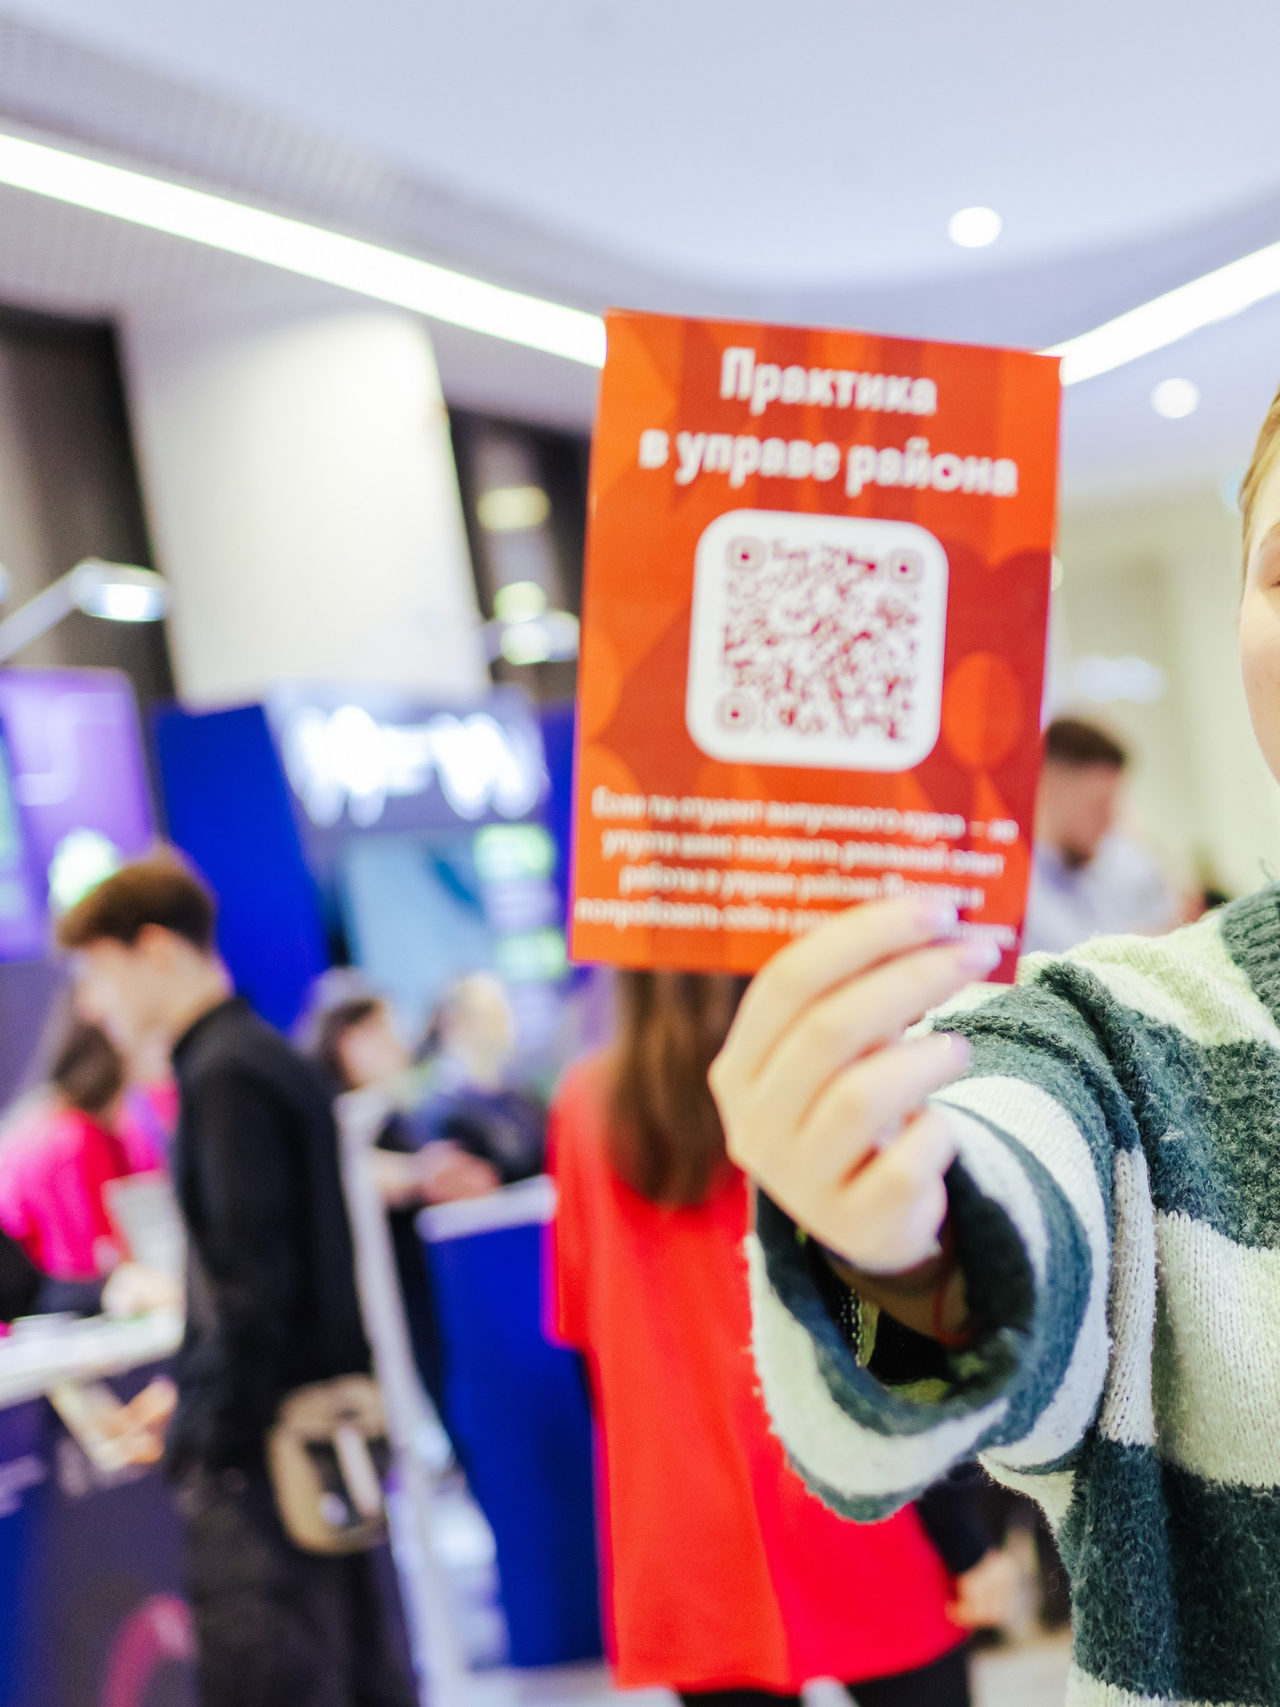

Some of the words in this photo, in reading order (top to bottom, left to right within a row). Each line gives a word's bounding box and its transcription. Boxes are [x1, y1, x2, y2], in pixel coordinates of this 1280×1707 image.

[720, 347, 937, 415] Практика
[639, 429, 669, 469] в
[675, 432, 841, 489] управе
[846, 437, 1018, 498] района
[592, 786, 646, 820] Если
[679, 797, 763, 830] студент
[902, 811, 966, 844] курса
[988, 818, 1019, 845] не
[602, 829, 679, 861] упусти
[736, 835, 838, 869] получить
[840, 841, 946, 872] реальный
[948, 849, 1006, 879] опыт
[619, 861, 702, 897] работы
[722, 870, 797, 902] управе
[798, 869, 880, 904] района
[574, 897, 720, 932] попробовать
[722, 903, 774, 932] себя
